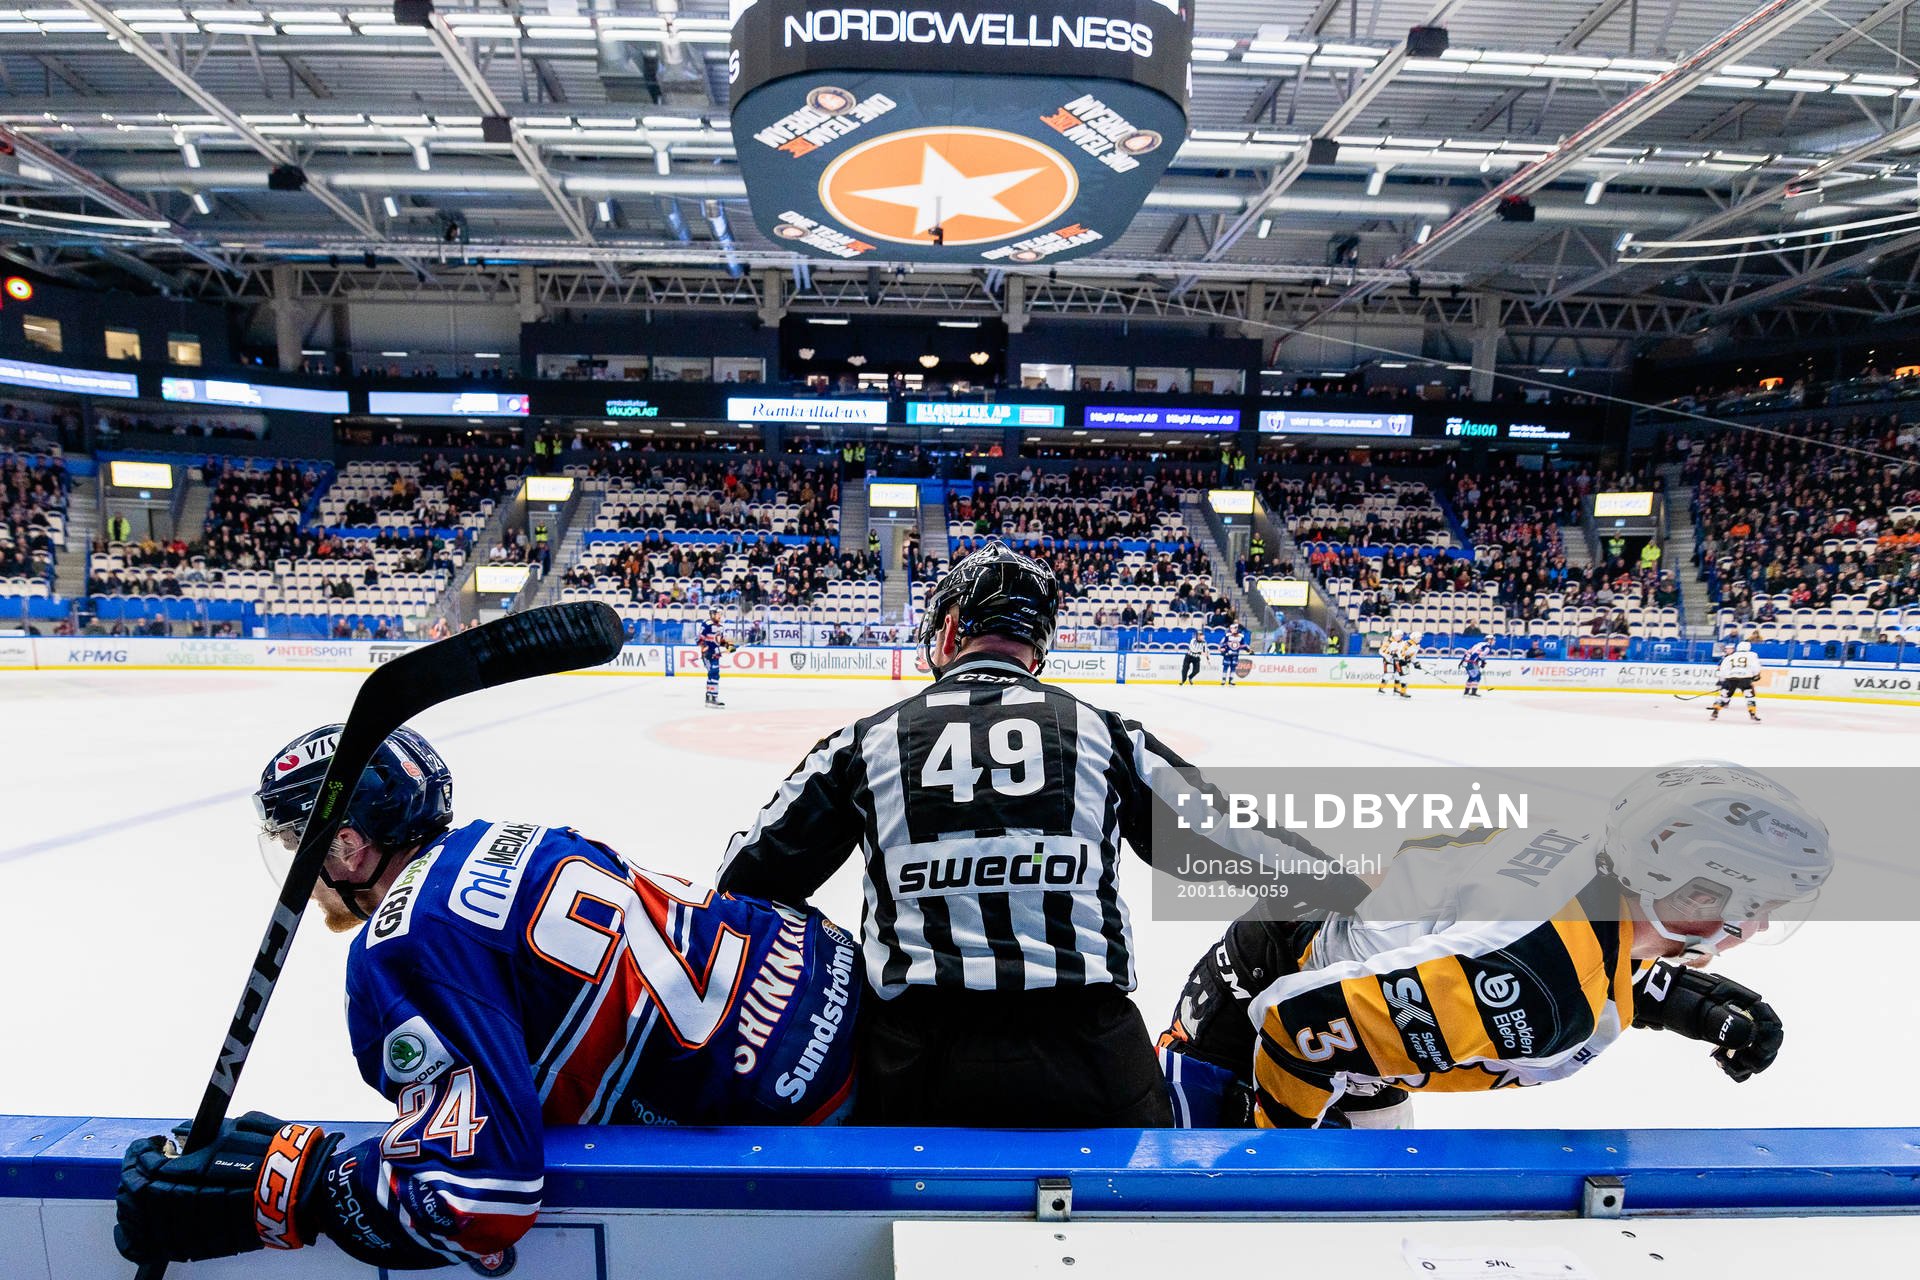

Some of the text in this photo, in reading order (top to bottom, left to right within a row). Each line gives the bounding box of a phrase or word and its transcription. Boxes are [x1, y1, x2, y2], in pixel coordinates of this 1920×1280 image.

[68, 649, 128, 662] KPMG
[168, 653, 255, 664] WELLNESS
[277, 646, 353, 657] INTERSPORT
[810, 651, 888, 671] hjalmarsbil.se
[1258, 665, 1318, 674] GEHAB.com
[1532, 666, 1606, 678] INTERSPORT
[1619, 666, 1669, 677] ACTIVE
[957, 673, 1019, 685] CCM
[1853, 677, 1912, 690] VÄXJÖ
[920, 717, 1046, 803] 49
[898, 841, 1089, 894] swedol
[1704, 860, 1758, 884] CCM
[774, 944, 856, 1105] Sundström
[1718, 1014, 1735, 1042] CCM
[1295, 1016, 1359, 1063] 3
[379, 1065, 489, 1159] 24
